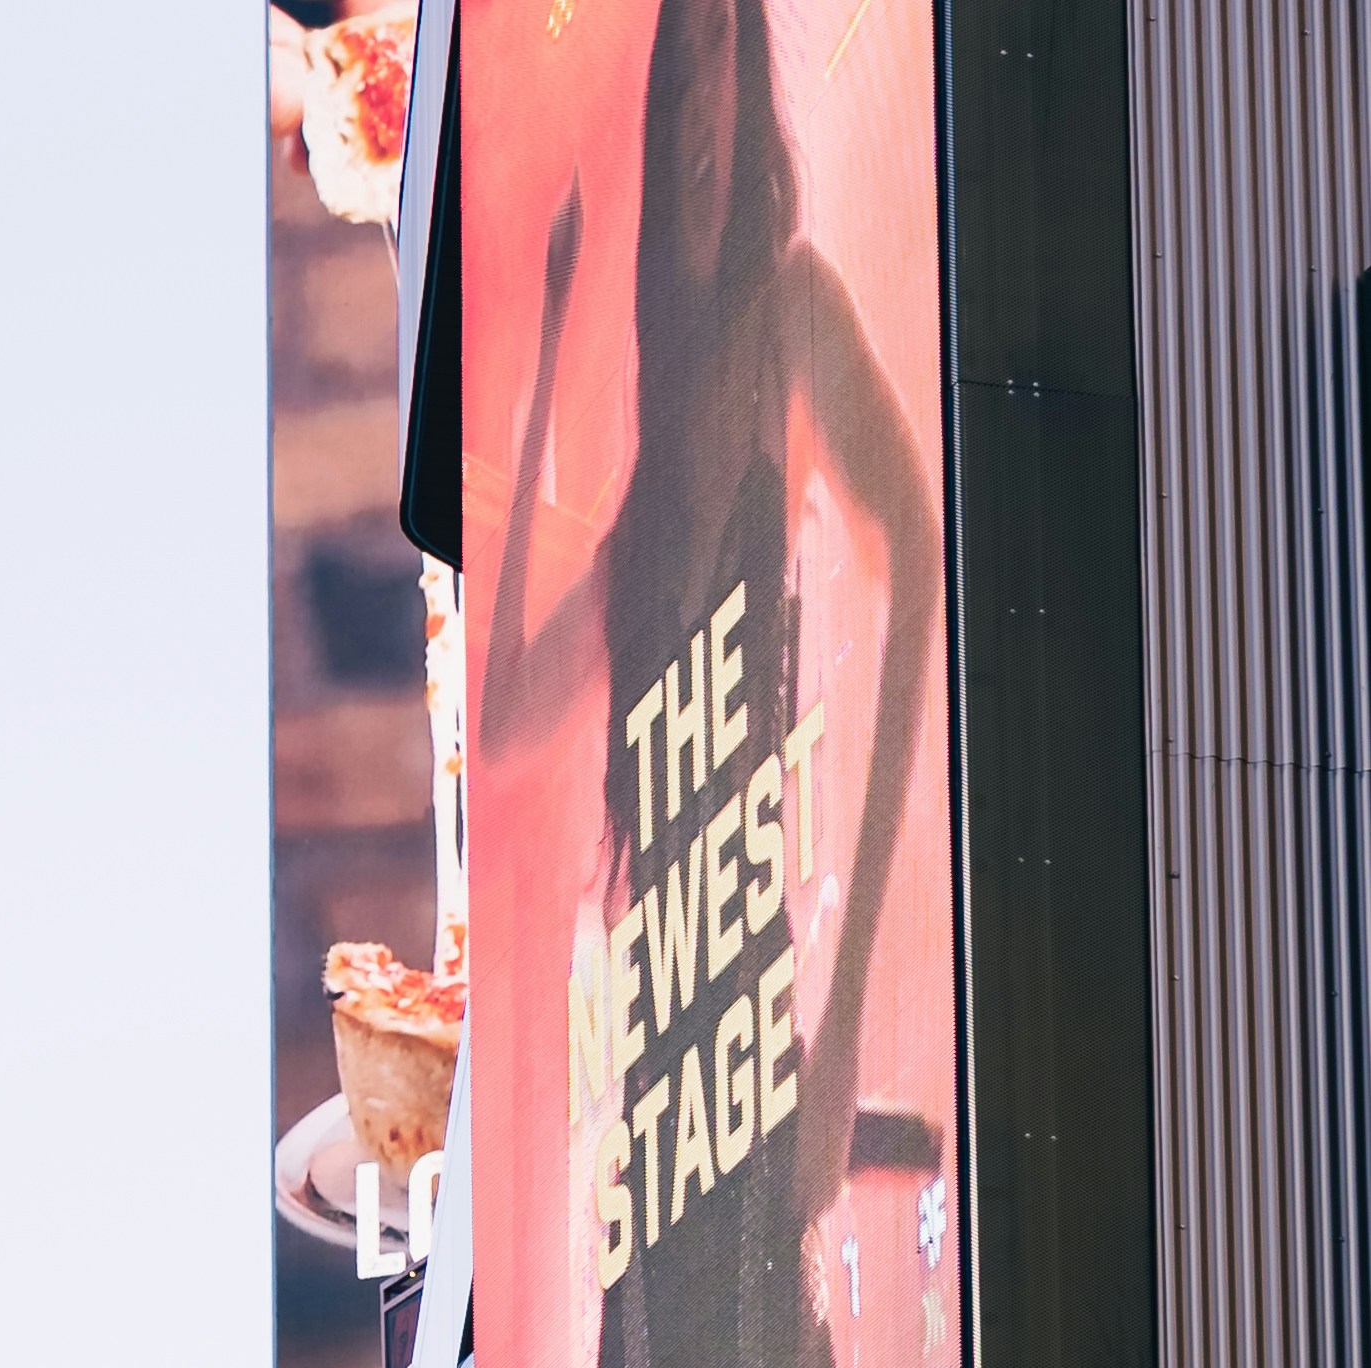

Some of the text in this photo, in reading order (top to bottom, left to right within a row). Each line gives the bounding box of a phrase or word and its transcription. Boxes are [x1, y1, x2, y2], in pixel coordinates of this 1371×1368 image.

[626, 579, 748, 855] THE
[568, 700, 825, 1126] NEWEST
[597, 947, 799, 1292] STAGE
